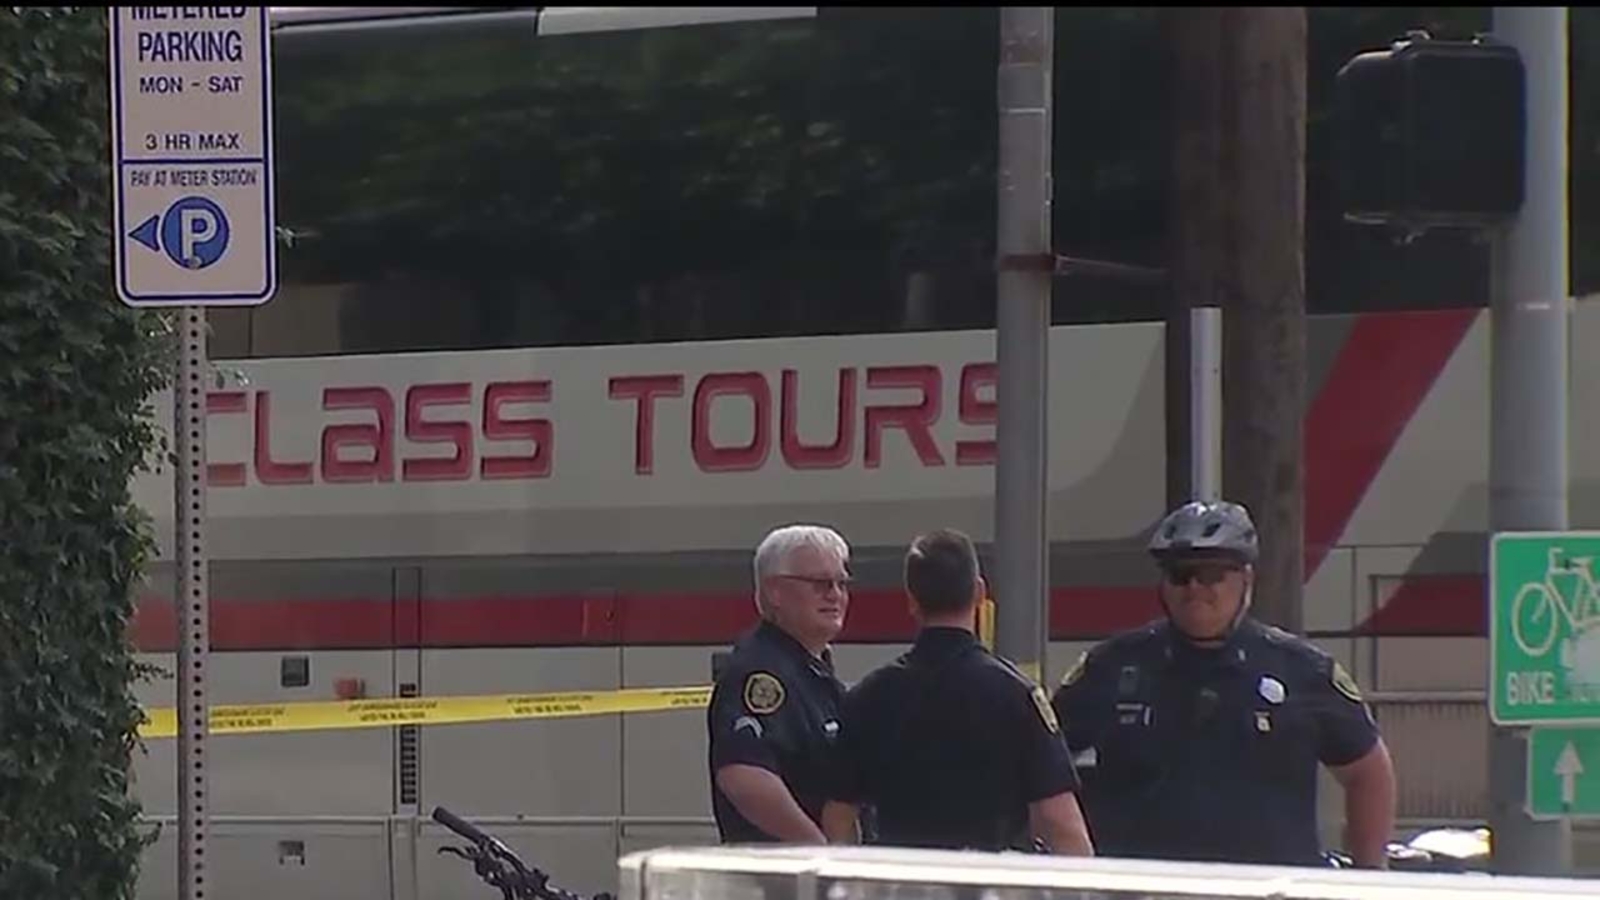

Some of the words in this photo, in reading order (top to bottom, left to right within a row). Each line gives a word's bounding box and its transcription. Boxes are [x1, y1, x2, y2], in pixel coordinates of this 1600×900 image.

[138, 30, 243, 62] PARKING
[140, 77, 182, 93] MON
[208, 76, 243, 92] SAT
[146, 134, 157, 150] 3
[165, 134, 191, 150] HR
[199, 133, 239, 149] MAX
[131, 171, 150, 186] PAY
[153, 170, 167, 186] AT
[170, 170, 208, 186] METER
[211, 169, 257, 186] STATION
[608, 362, 997, 475] TOURS
[1507, 671, 1555, 704] BIKE
